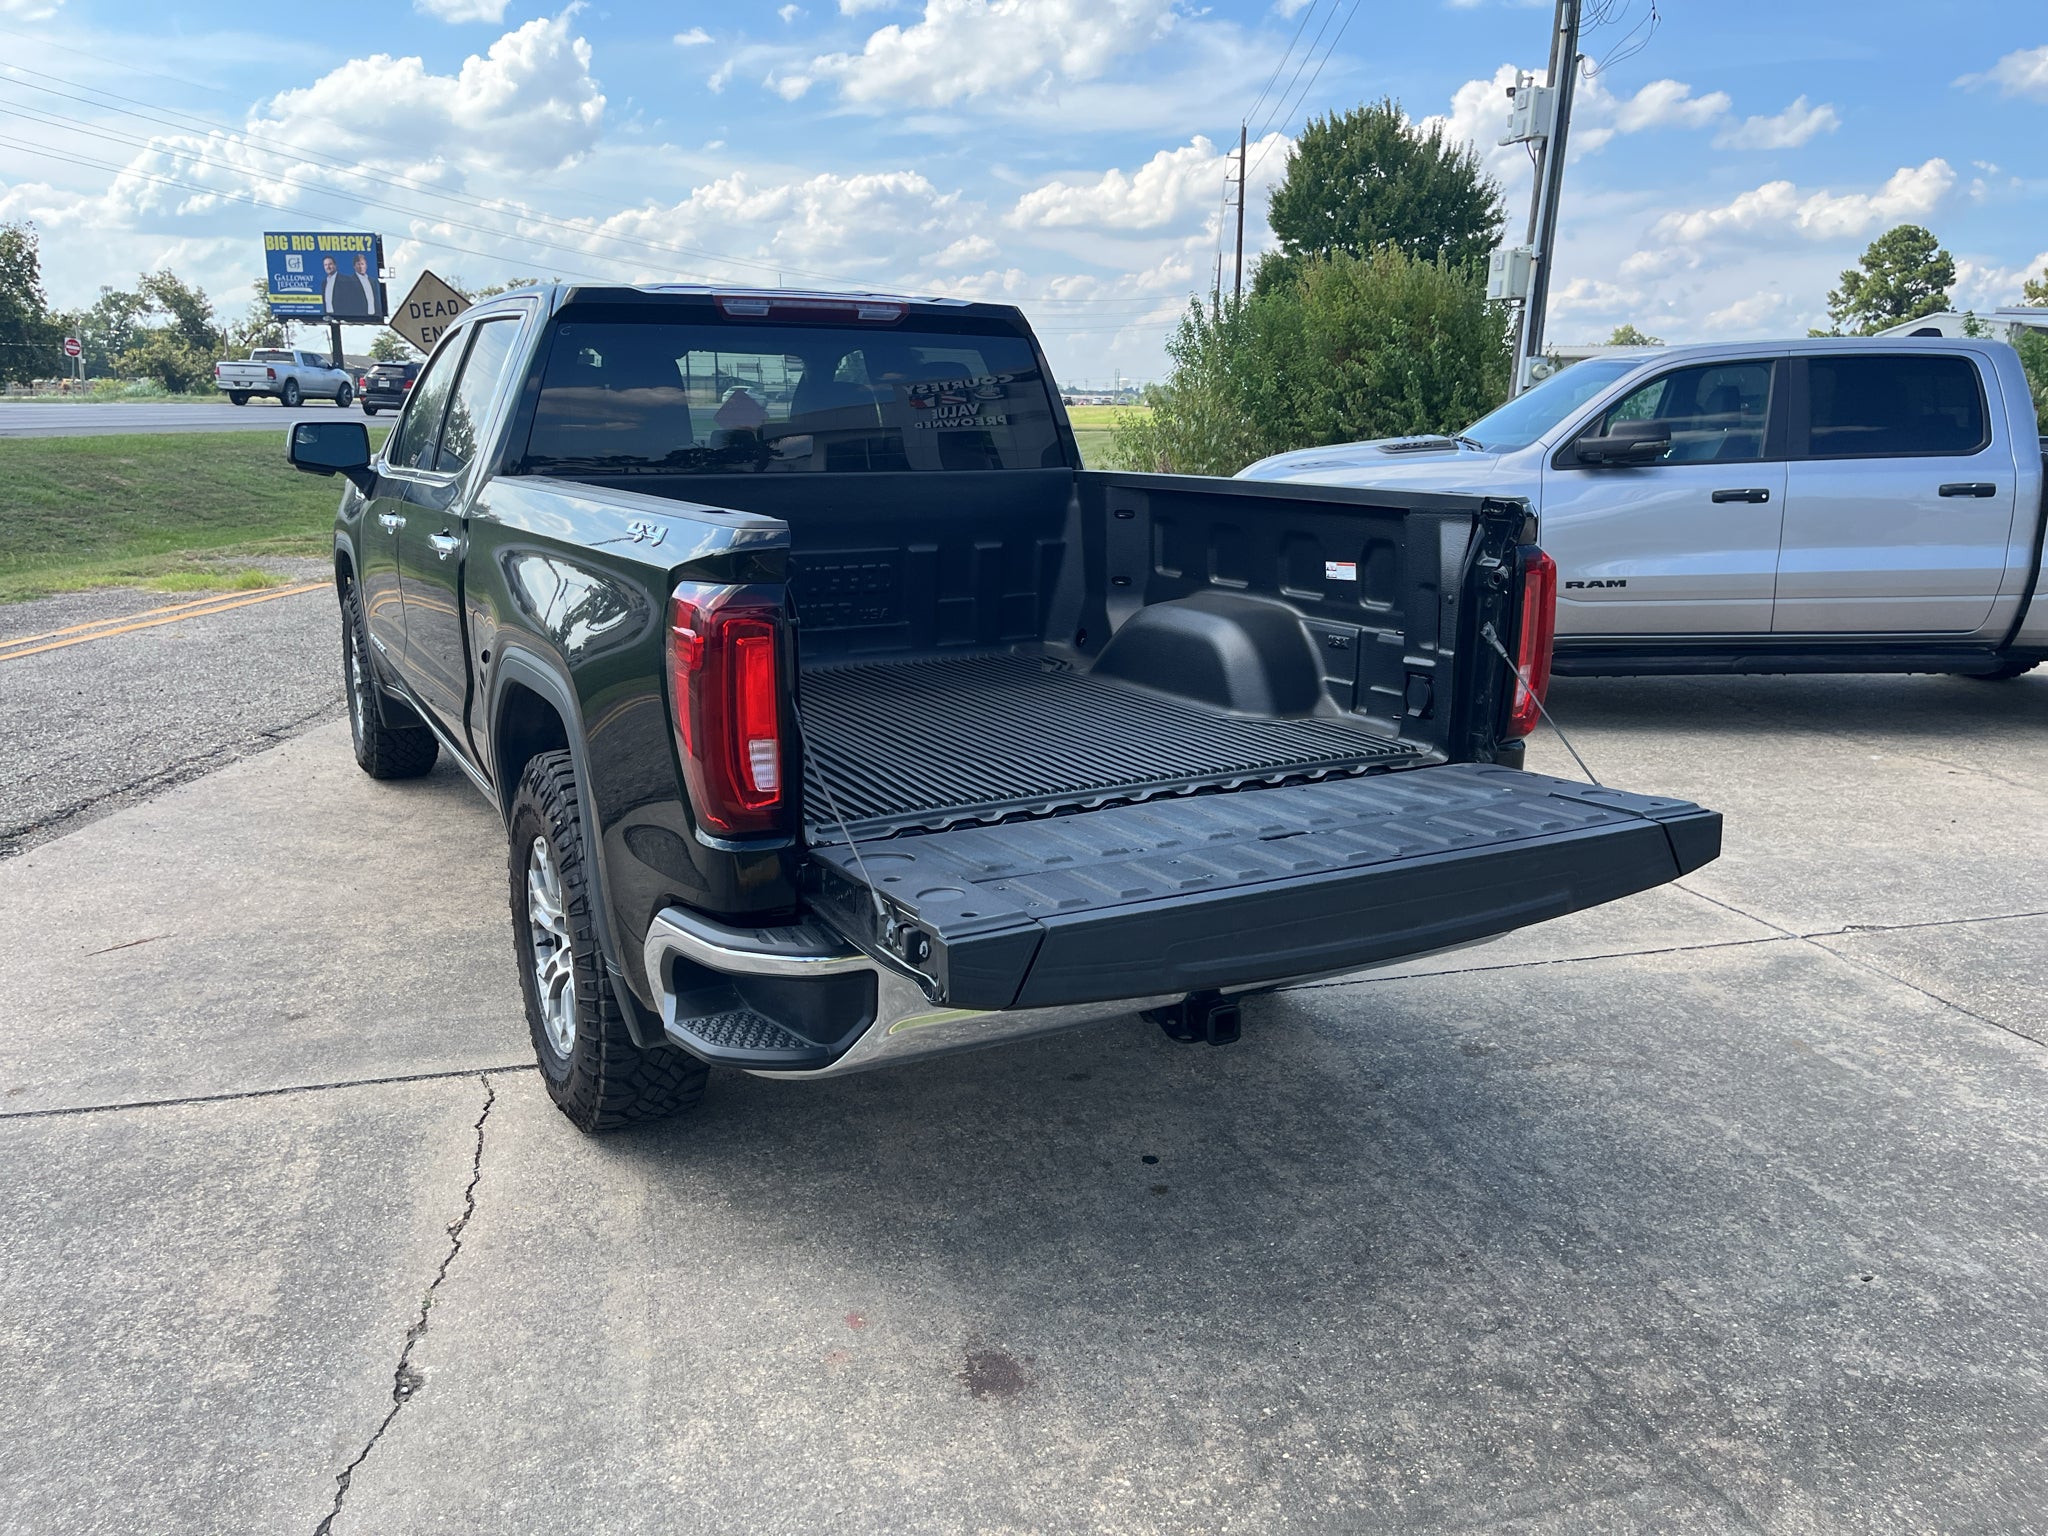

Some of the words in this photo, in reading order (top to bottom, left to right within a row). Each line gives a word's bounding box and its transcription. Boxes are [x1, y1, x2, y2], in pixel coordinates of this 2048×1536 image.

[264, 235, 288, 251] BIG
[291, 235, 315, 251] RIG
[317, 235, 372, 252] WRECK?
[273, 273, 313, 282] GALLOWAY
[409, 300, 459, 319] DEAD
[421, 325, 449, 343] EN
[1565, 580, 1627, 589] RAM
